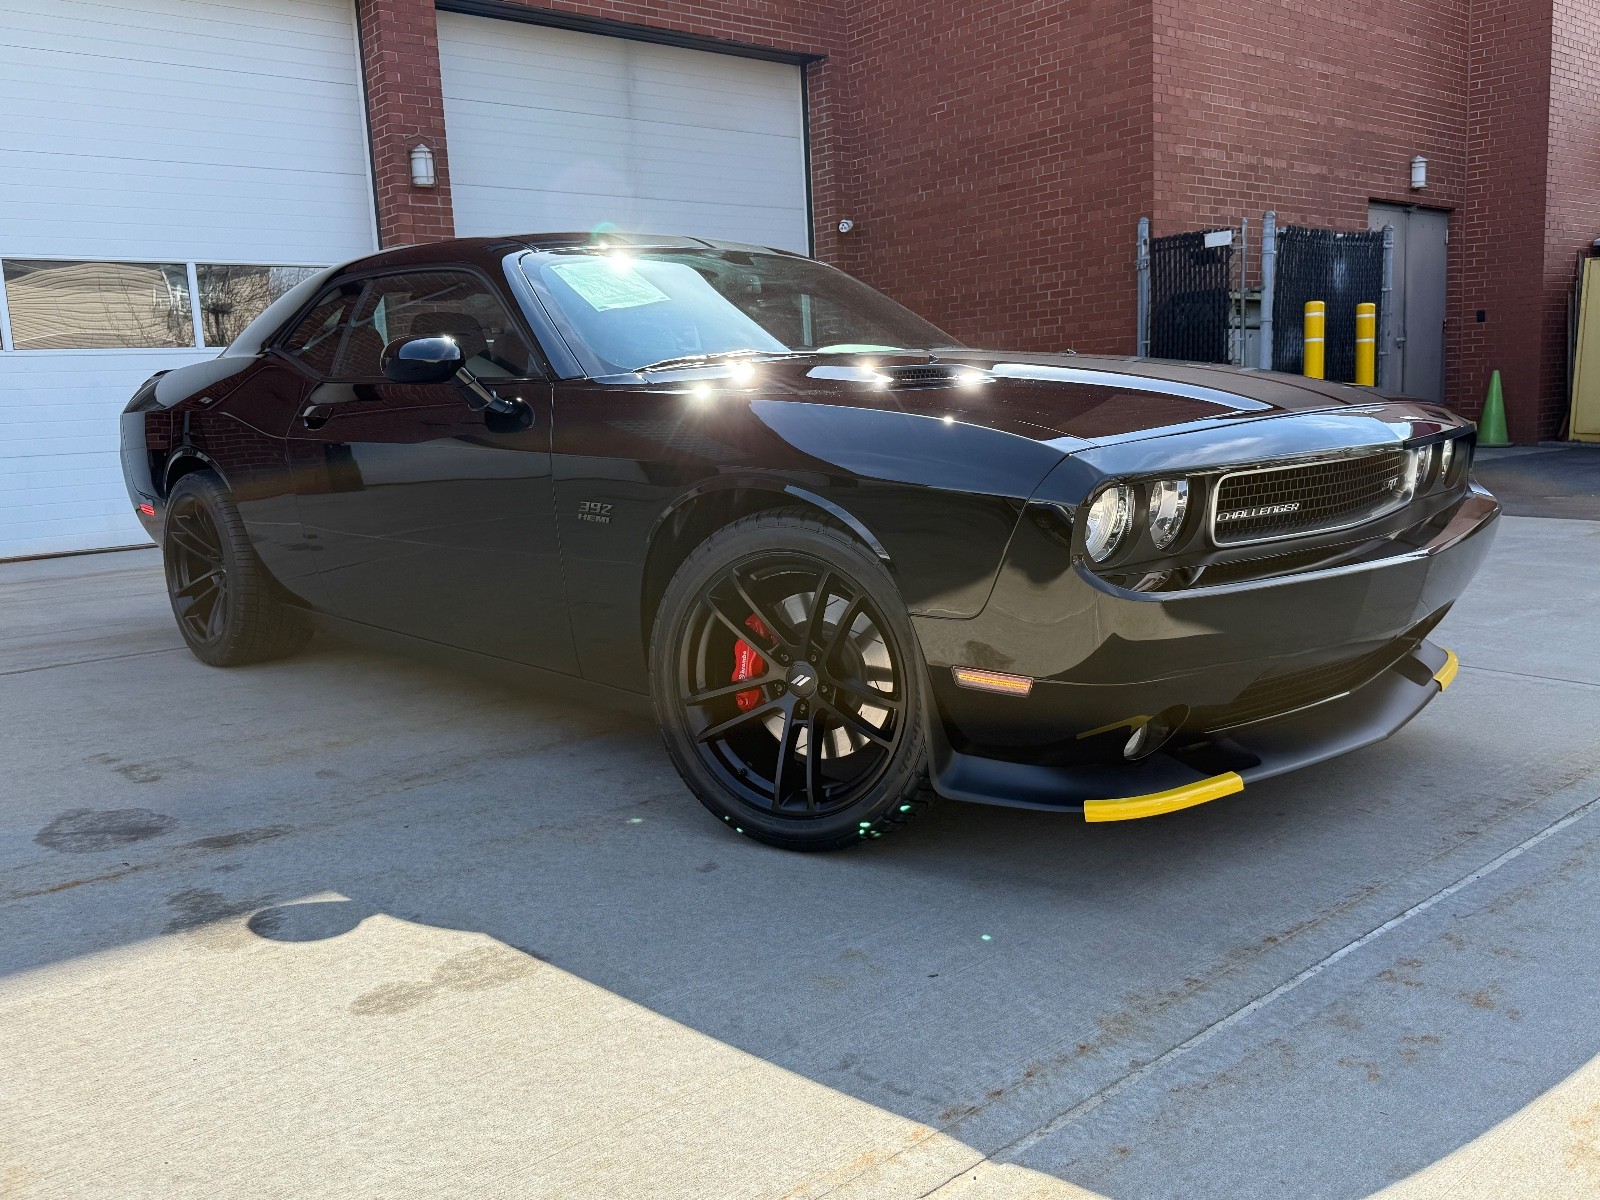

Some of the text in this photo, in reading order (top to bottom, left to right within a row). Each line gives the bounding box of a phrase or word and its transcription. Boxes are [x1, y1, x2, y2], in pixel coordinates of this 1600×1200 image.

[578, 501, 613, 515] 392
[1216, 502, 1300, 522] CHALLENGER
[577, 513, 610, 524] HEMI
